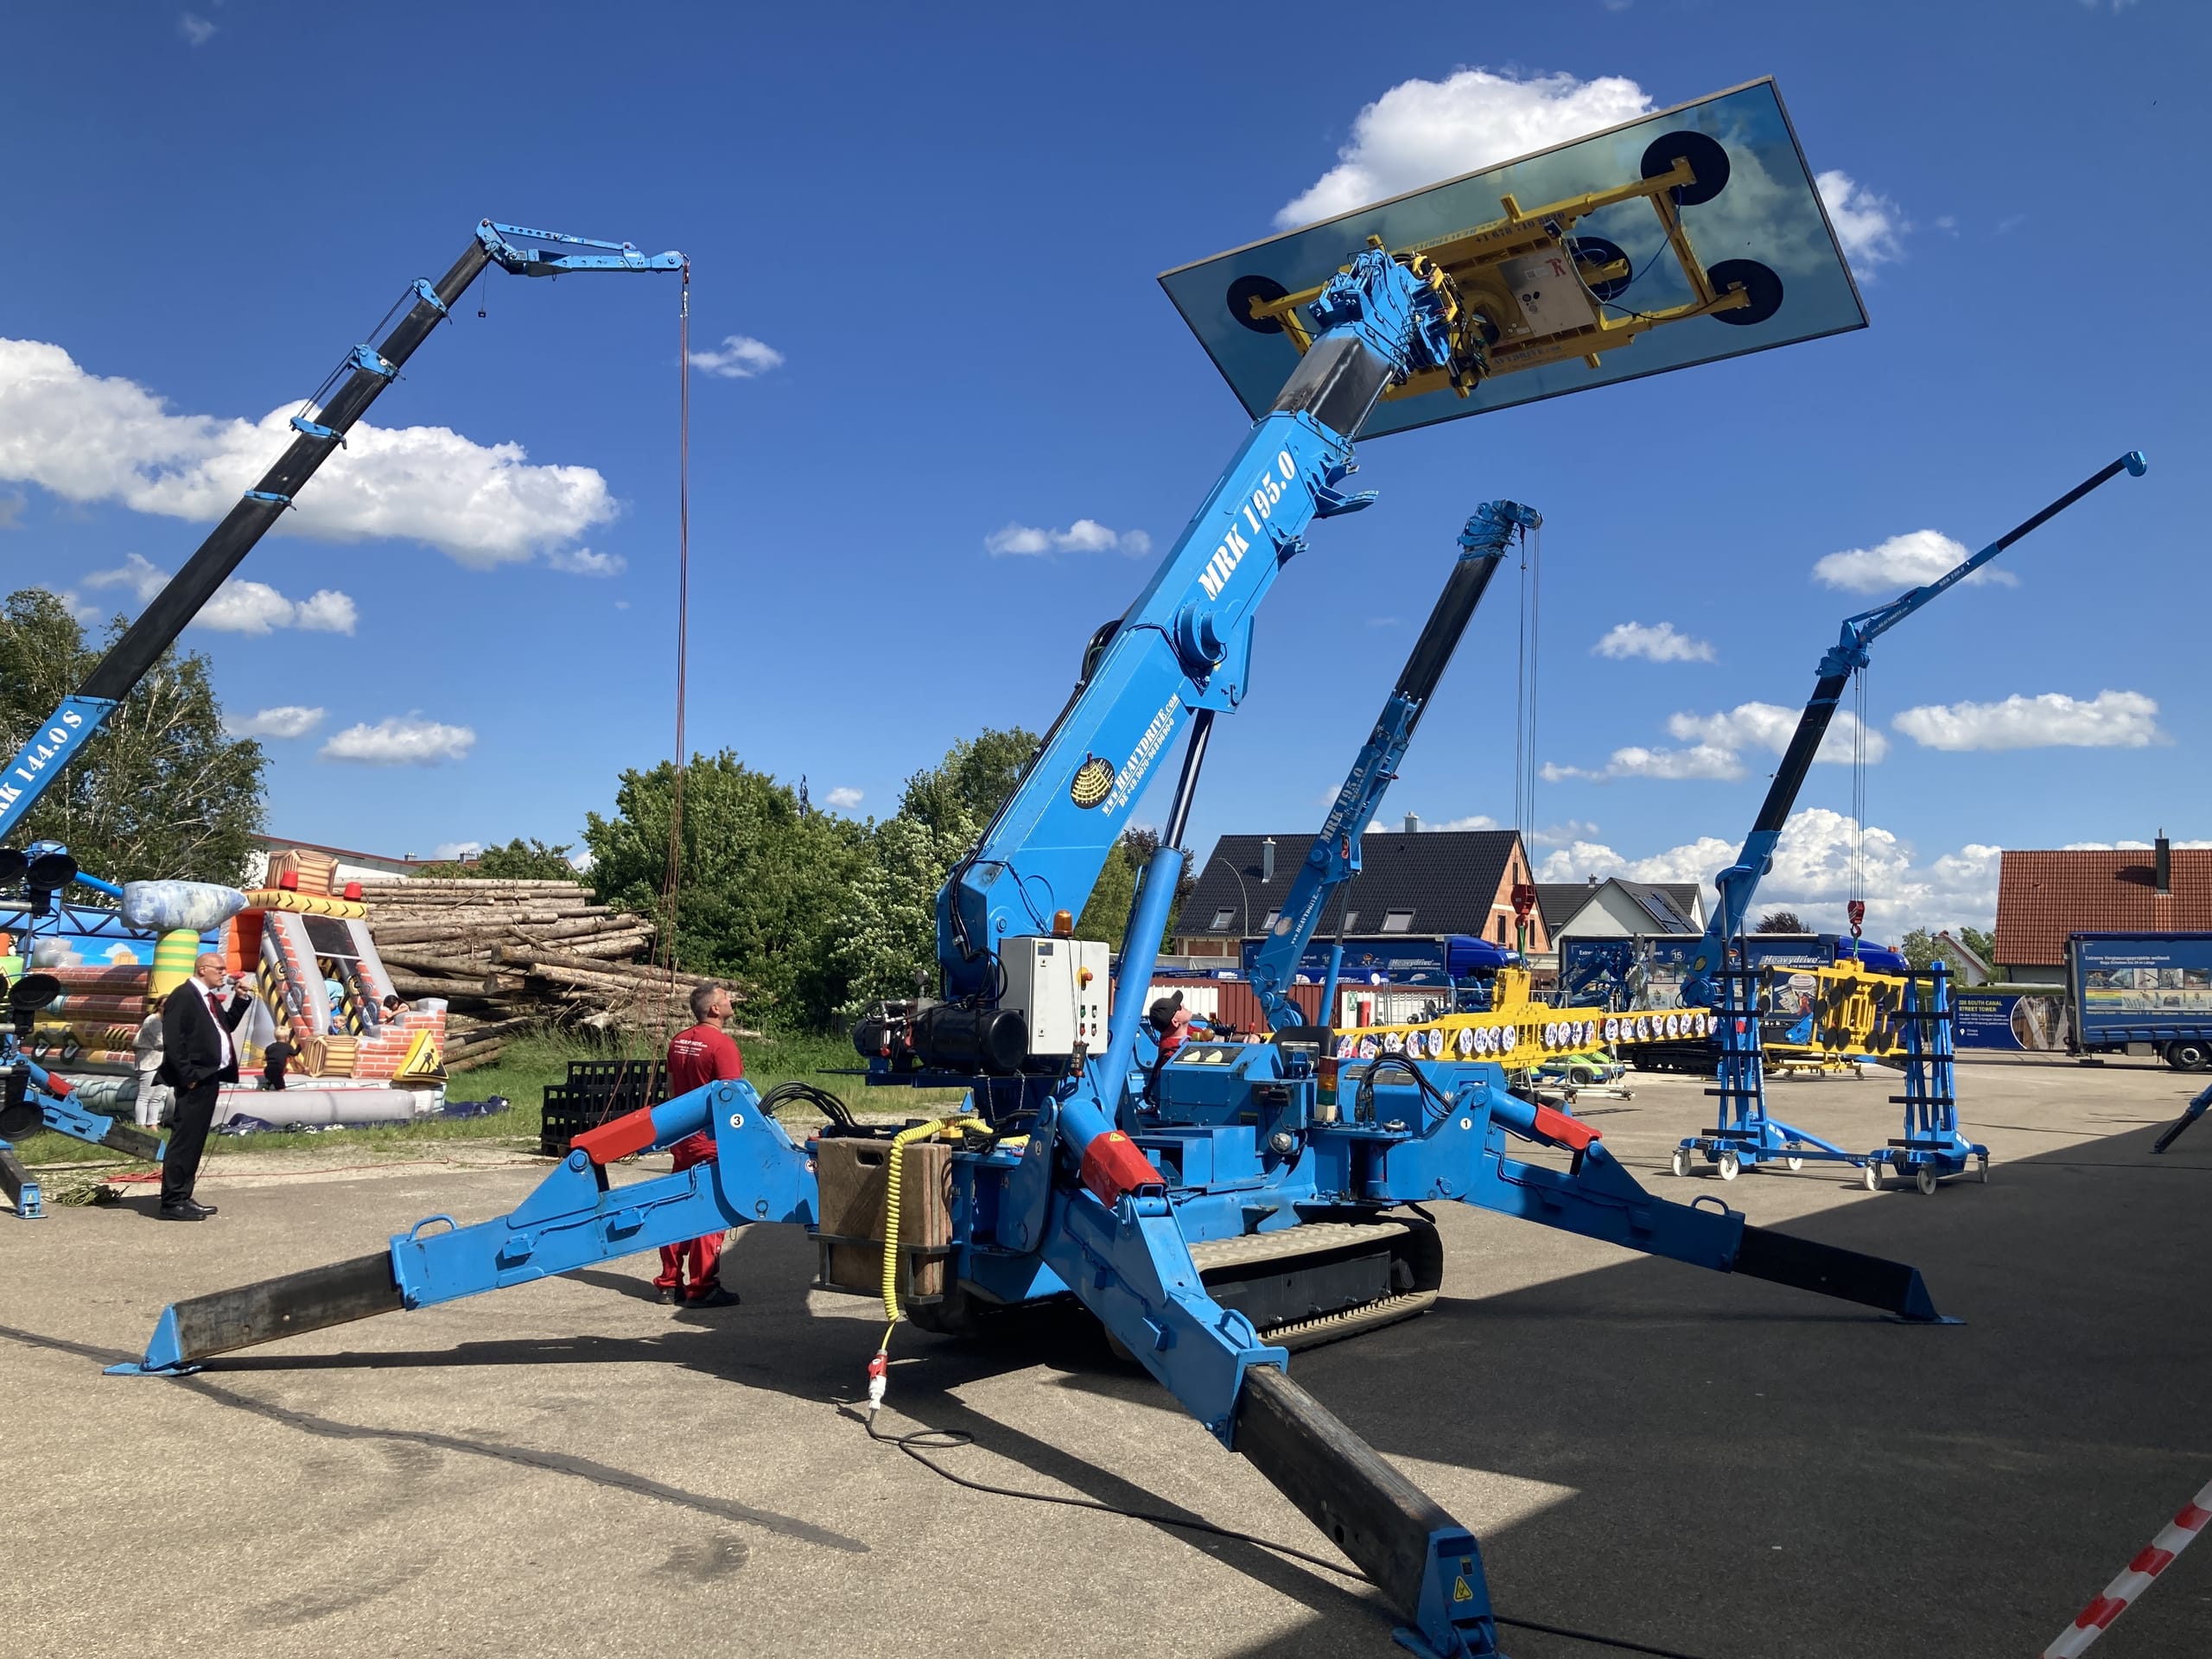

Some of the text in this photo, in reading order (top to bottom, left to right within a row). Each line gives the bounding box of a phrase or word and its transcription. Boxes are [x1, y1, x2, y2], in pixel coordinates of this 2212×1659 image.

[1198, 450, 1295, 602] MRK 195.0
[15, 727, 68, 782] 144.0
[62, 709, 82, 729] S
[1118, 795, 1129, 808] DE
[1319, 809, 1343, 844] MRK
[1338, 766, 1364, 806] 195.0
[1672, 951, 1681, 960] 15
[734, 1116, 741, 1126] 3
